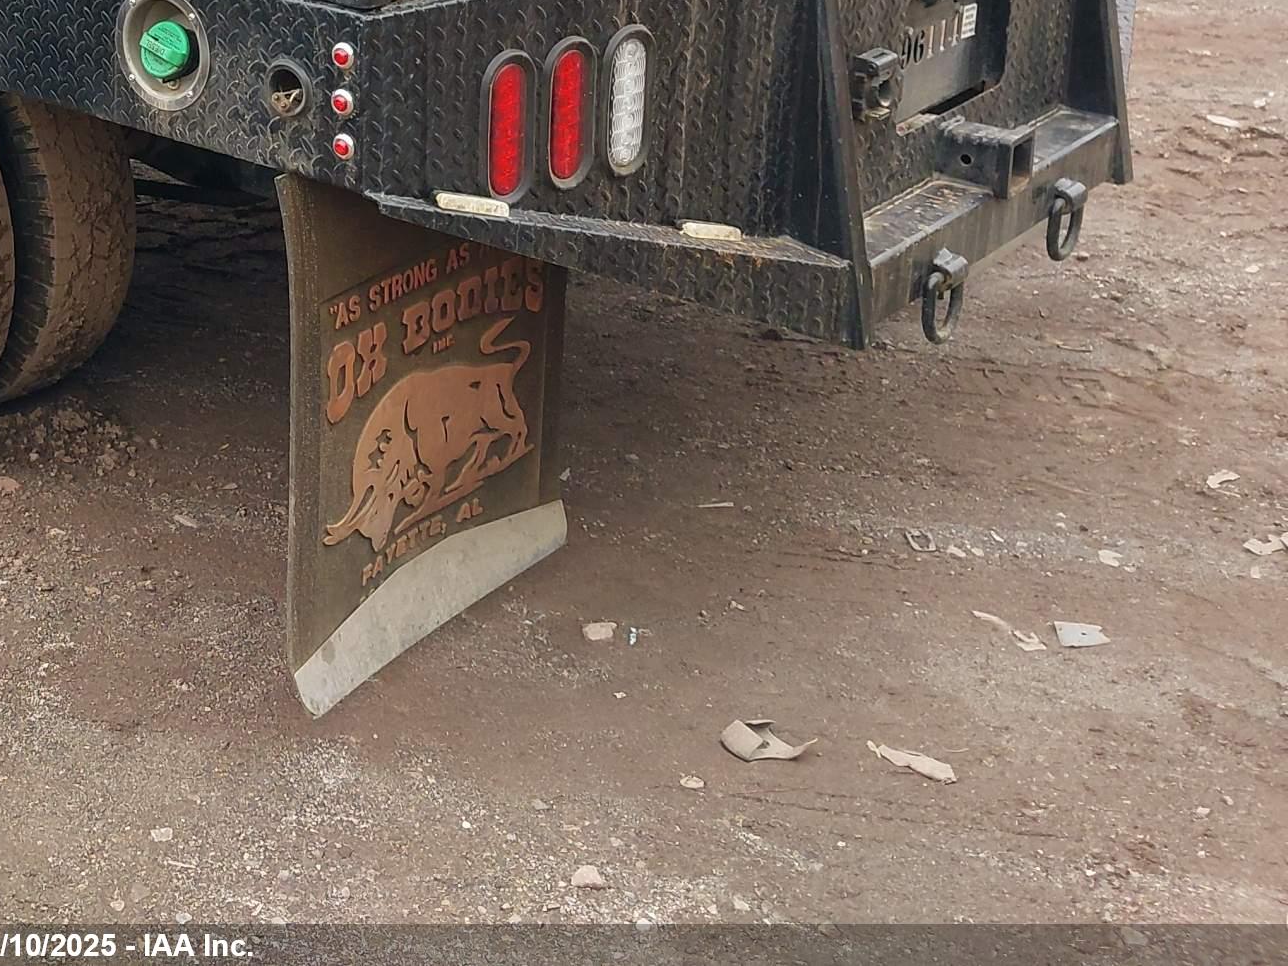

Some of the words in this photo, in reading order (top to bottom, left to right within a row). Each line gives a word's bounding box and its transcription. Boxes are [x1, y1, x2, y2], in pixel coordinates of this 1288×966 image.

[368, 258, 439, 312] STRONG
[446, 242, 471, 275] AS
[326, 321, 388, 425] OX
[401, 256, 545, 356] BODIES
[456, 497, 484, 523] AL
